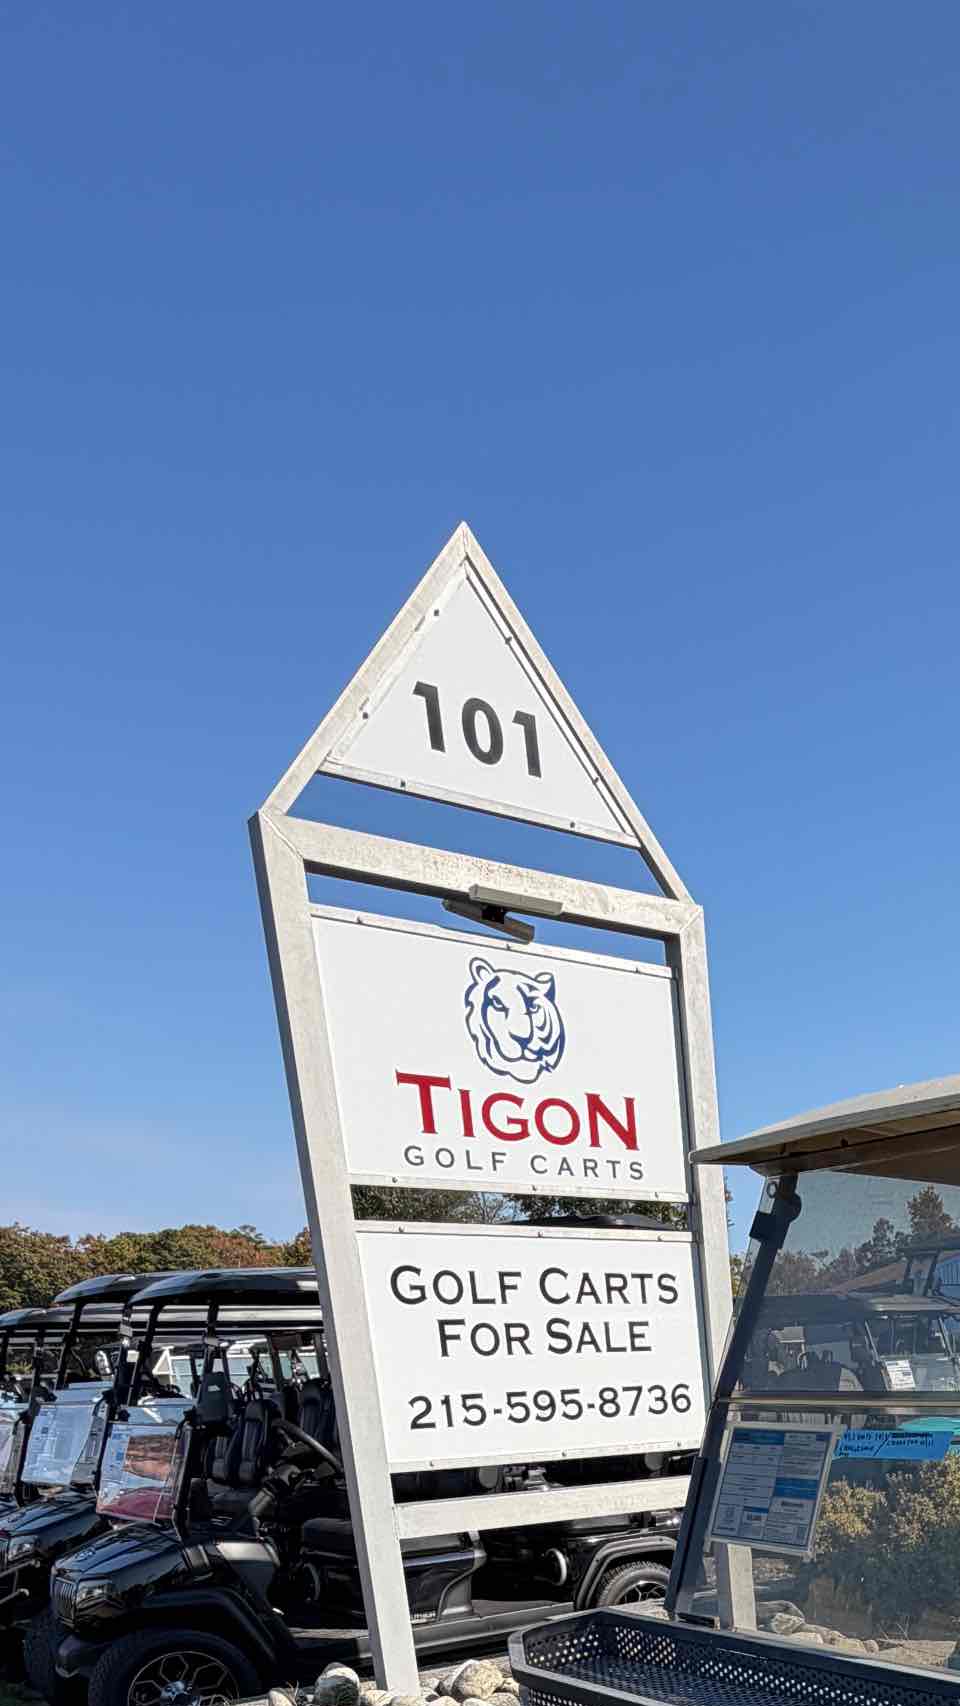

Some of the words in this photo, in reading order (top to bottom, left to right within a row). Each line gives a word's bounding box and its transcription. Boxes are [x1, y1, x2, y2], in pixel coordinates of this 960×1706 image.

[412, 681, 542, 778] 101
[394, 1069, 641, 1152] TIGON
[403, 1145, 507, 1172] GOLF
[530, 1154, 644, 1181] CARTS
[390, 1264, 522, 1306] GOLF
[539, 1267, 679, 1306] CARTS
[437, 1318, 533, 1357] FOR
[546, 1317, 652, 1355] SALE
[408, 1383, 692, 1430] 215-595-8736
